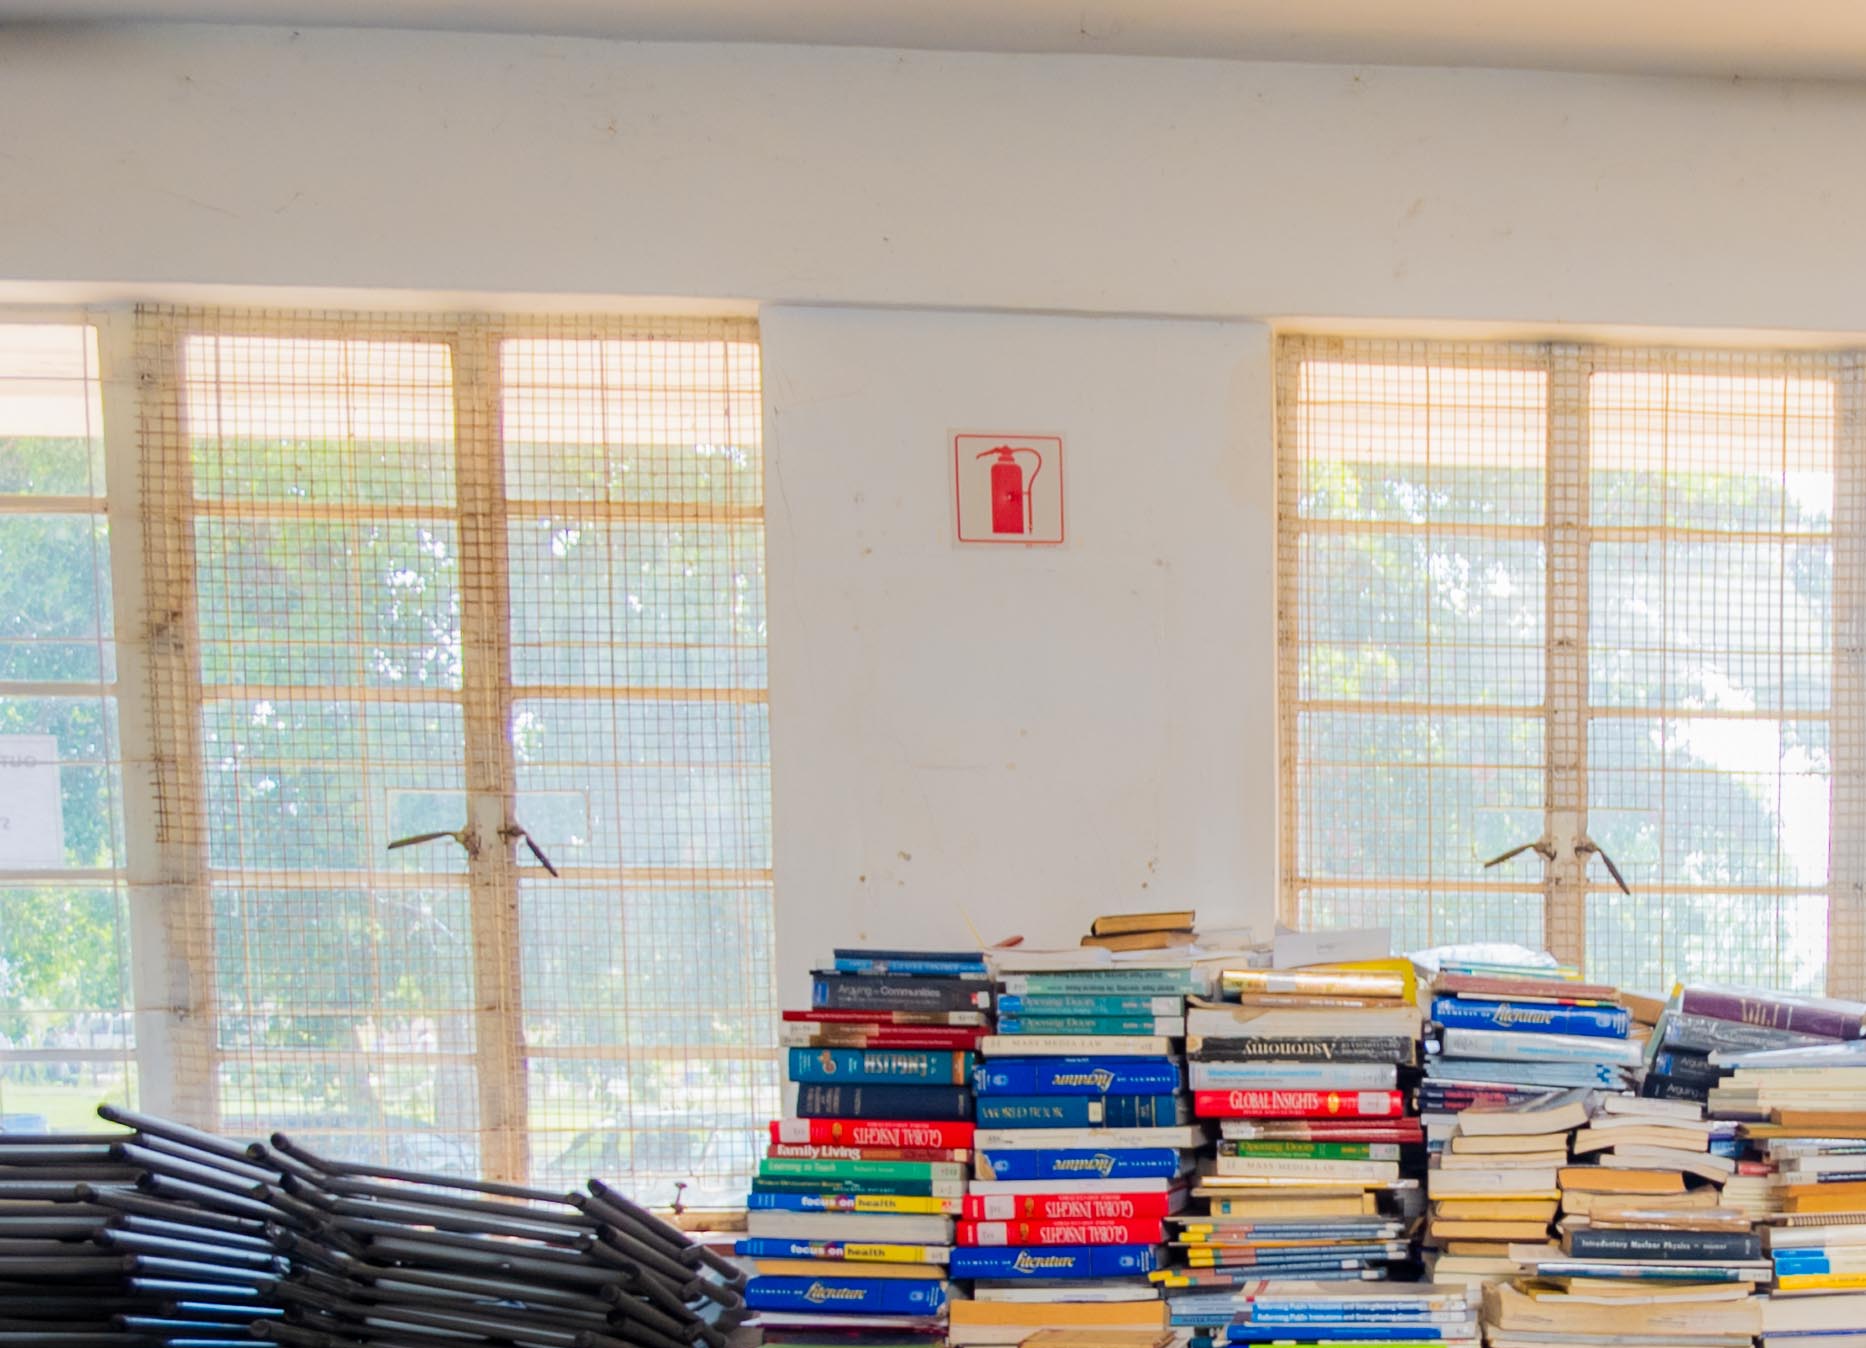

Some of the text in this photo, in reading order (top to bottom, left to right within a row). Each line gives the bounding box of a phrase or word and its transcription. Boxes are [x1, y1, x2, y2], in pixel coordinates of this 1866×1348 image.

[1242, 1040, 1337, 1060] Astronomy
[864, 1054, 928, 1077] ENGLISH
[1052, 1068, 1116, 1092] Literature
[1229, 1090, 1320, 1109] GLOBAL INSIGHTS
[853, 1126, 942, 1148] GLOBAL INSIGHTS
[777, 1144, 861, 1160] Family Living
[1052, 1153, 1116, 1177] Literature
[801, 1196, 896, 1208] focus on health
[1045, 1200, 1134, 1219] GLOBAL INSIGHTS
[1039, 1225, 1128, 1244] GLOBAL INSIGHTS
[790, 1243, 885, 1257] focus on health
[1581, 1239, 1628, 1251] Introductory
[1663, 1240, 1691, 1252] Physics
[1012, 1250, 1076, 1274] Literature
[803, 1281, 867, 1303] Literature
